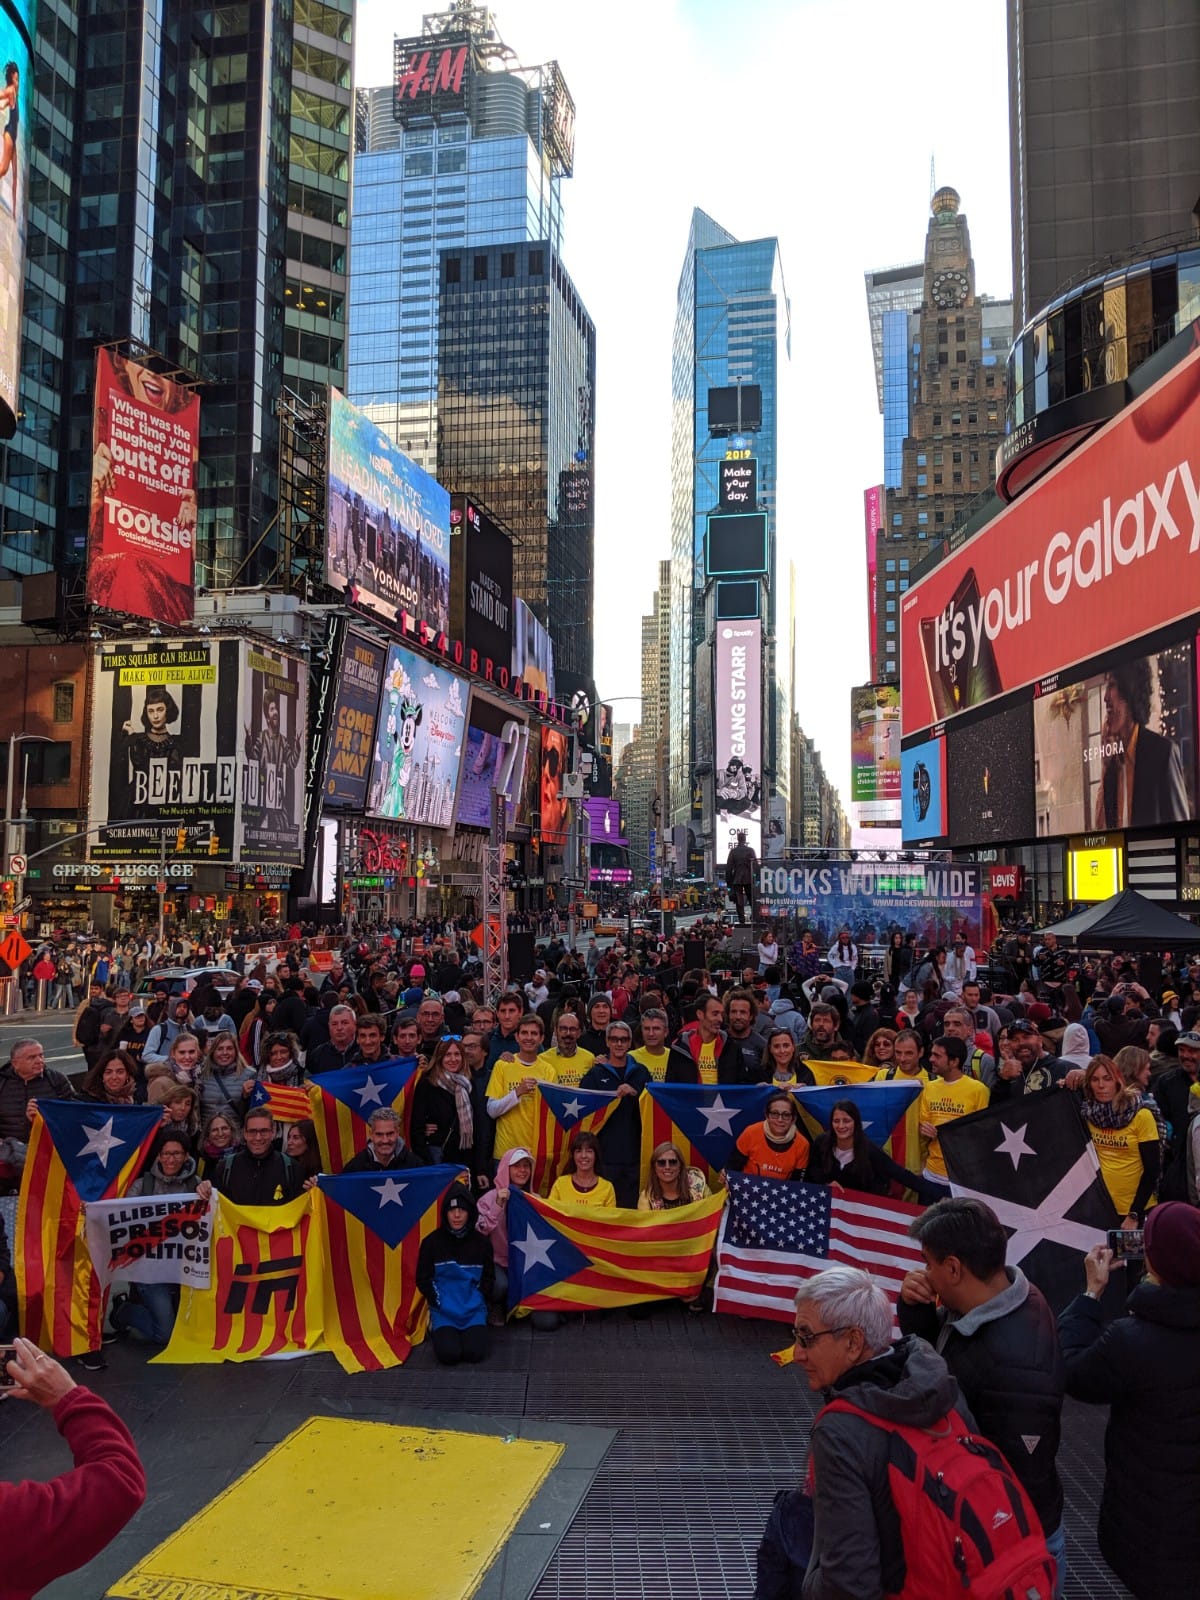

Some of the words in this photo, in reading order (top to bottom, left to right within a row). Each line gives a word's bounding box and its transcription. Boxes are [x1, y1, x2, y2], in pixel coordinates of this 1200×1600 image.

[396, 46, 469, 101] H&M
[112, 409, 135, 430] last
[139, 421, 166, 442] time
[169, 436, 190, 453] you
[150, 415, 171, 432] was
[173, 424, 190, 440] the
[111, 423, 161, 455] laughed
[163, 447, 190, 466] your
[725, 449, 751, 460] 2019
[111, 438, 157, 475] butt
[160, 464, 190, 487] off
[114, 464, 126, 476] at
[128, 470, 135, 479] a
[724, 467, 752, 477] Make
[726, 479, 749, 491] your
[728, 491, 749, 502] day.
[340, 452, 391, 509] LEADING
[394, 495, 443, 549] LANDLORD
[104, 496, 192, 549] Tootsie
[450, 526, 461, 536] LG
[117, 527, 180, 555] TootsieMusical.com
[935, 600, 966, 673] It's
[968, 559, 1039, 668] your
[1044, 459, 1200, 605] Galaxy
[371, 563, 418, 605] VORNADO
[480, 571, 494, 593] MADE
[471, 580, 494, 622] STAND
[495, 599, 509, 632] OUT
[104, 655, 126, 668] TIMES
[128, 653, 158, 667] SQUARE
[160, 652, 176, 664] CAN
[178, 650, 207, 663] REALLY
[401, 611, 463, 664] 1540
[470, 648, 566, 723] BROADWAY
[123, 671, 145, 682] MAKE
[148, 670, 163, 682] YOU
[166, 670, 185, 681] FEEL
[188, 668, 213, 681] ALIVE!
[731, 645, 746, 700] STARR
[338, 705, 374, 735] COME
[430, 710, 456, 728] WELCOME
[731, 704, 746, 757] GANG
[331, 750, 368, 777] AWAY
[501, 721, 529, 805] 21
[1083, 740, 1125, 762] SEPHORA
[134, 763, 235, 805] BEETLE
[729, 828, 749, 836] ONE
[728, 842, 750, 850] BET
[52, 865, 100, 877] GIFTS
[114, 865, 193, 877] LUGGAGE
[261, 864, 292, 876] LUGGAGE
[760, 866, 832, 896] ROCKS
[930, 1106, 965, 1114] CATALONIA
[1094, 1139, 1129, 1147] ATALONIA
[110, 1218, 209, 1244] PRESOS
